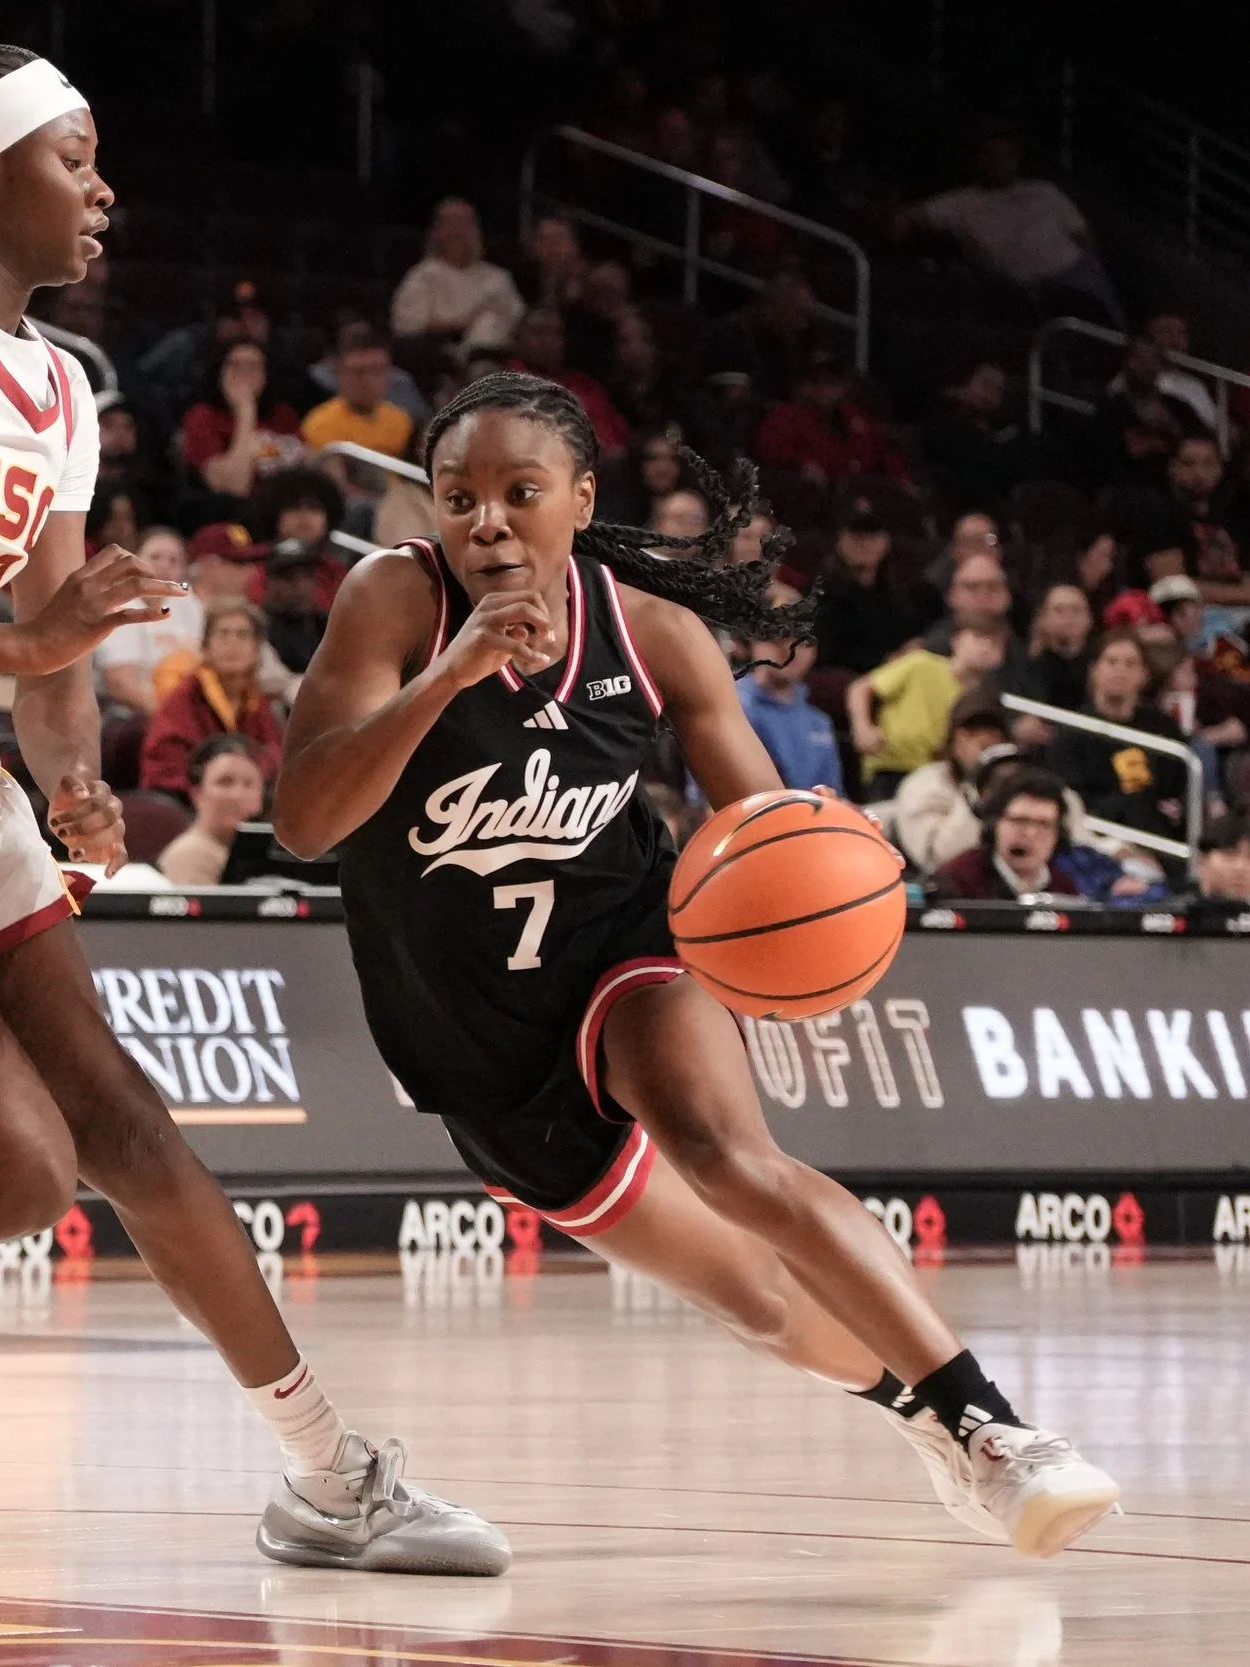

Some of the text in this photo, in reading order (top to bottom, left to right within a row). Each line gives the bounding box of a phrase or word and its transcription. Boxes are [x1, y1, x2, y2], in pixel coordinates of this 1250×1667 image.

[493, 880, 555, 970] 7
[116, 1035, 300, 1103] NION
[962, 1006, 1250, 1099] BANKI
[397, 1200, 505, 1253] ARCO
[1015, 1191, 1111, 1242] ARCO
